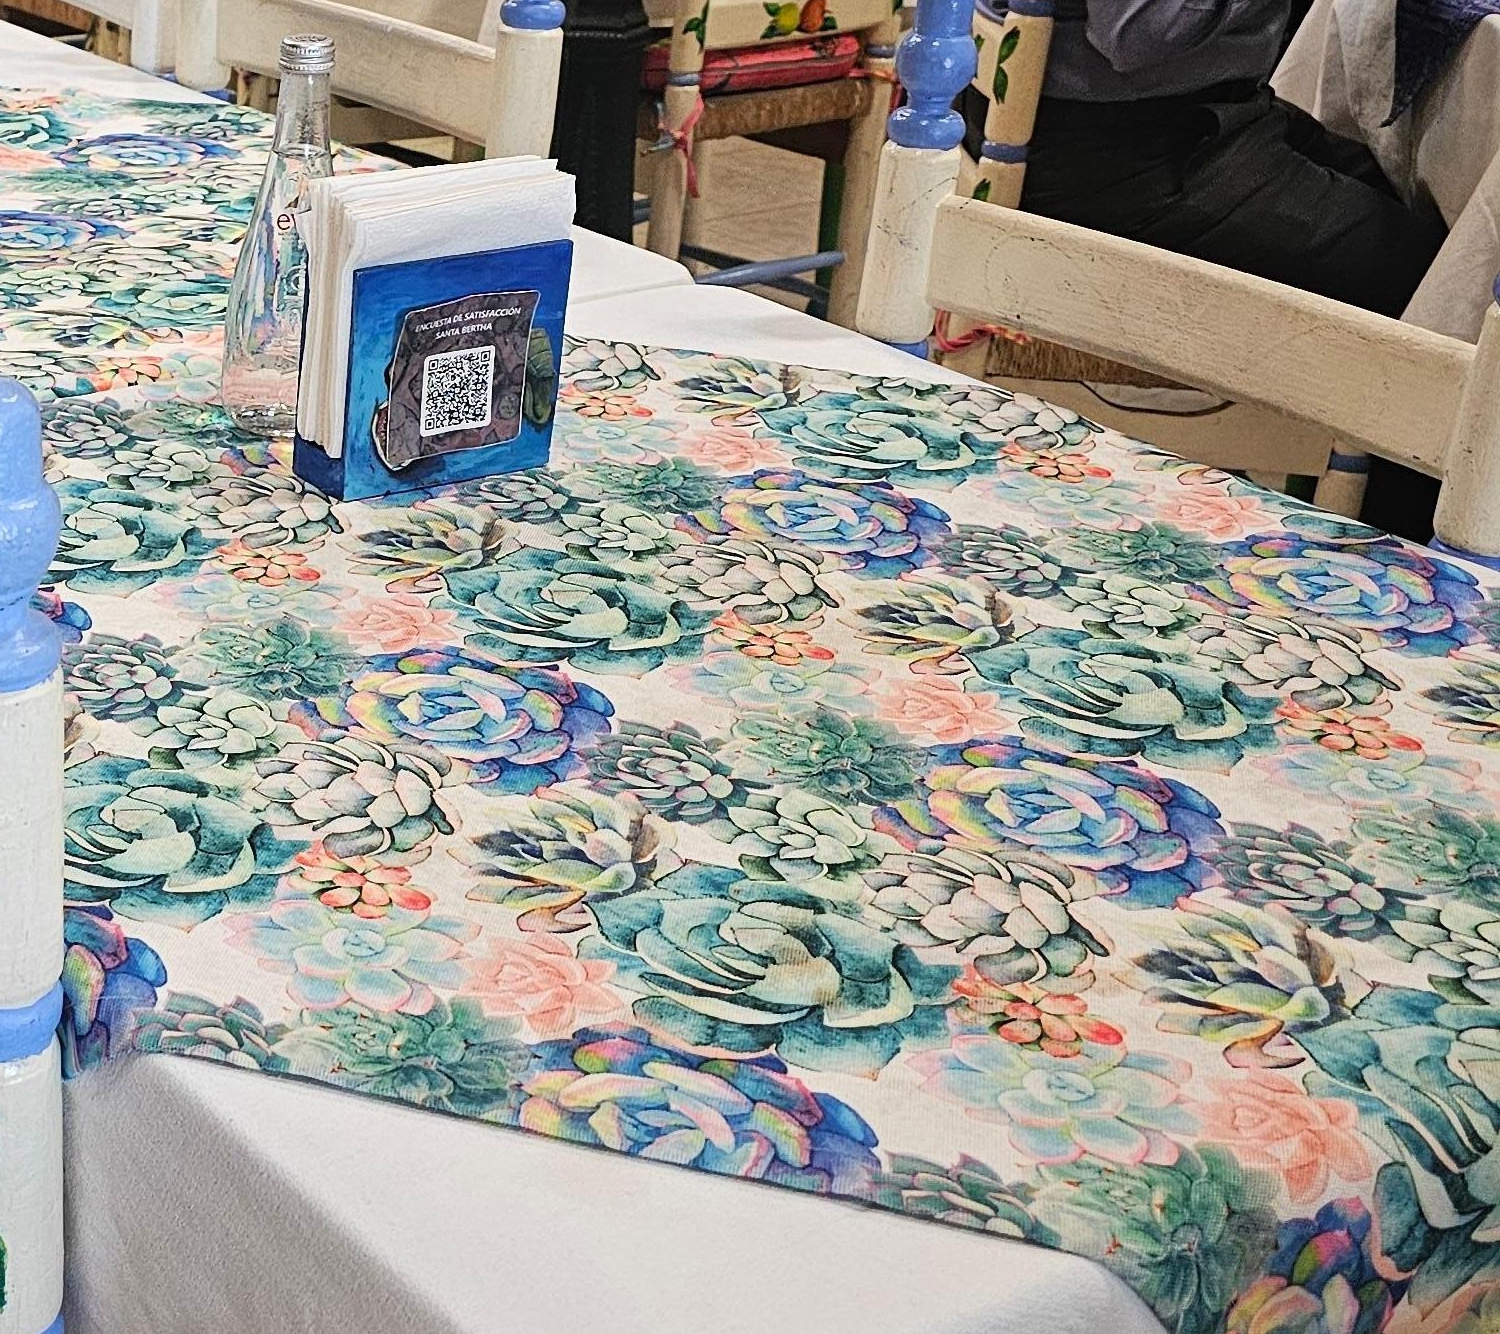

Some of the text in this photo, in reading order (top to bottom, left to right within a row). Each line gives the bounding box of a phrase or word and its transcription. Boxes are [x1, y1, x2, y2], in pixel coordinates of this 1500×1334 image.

[414, 307, 522, 333] ENCUESTA DE SATISFACCIÓN
[435, 323, 493, 340] SANTA BERTHA
